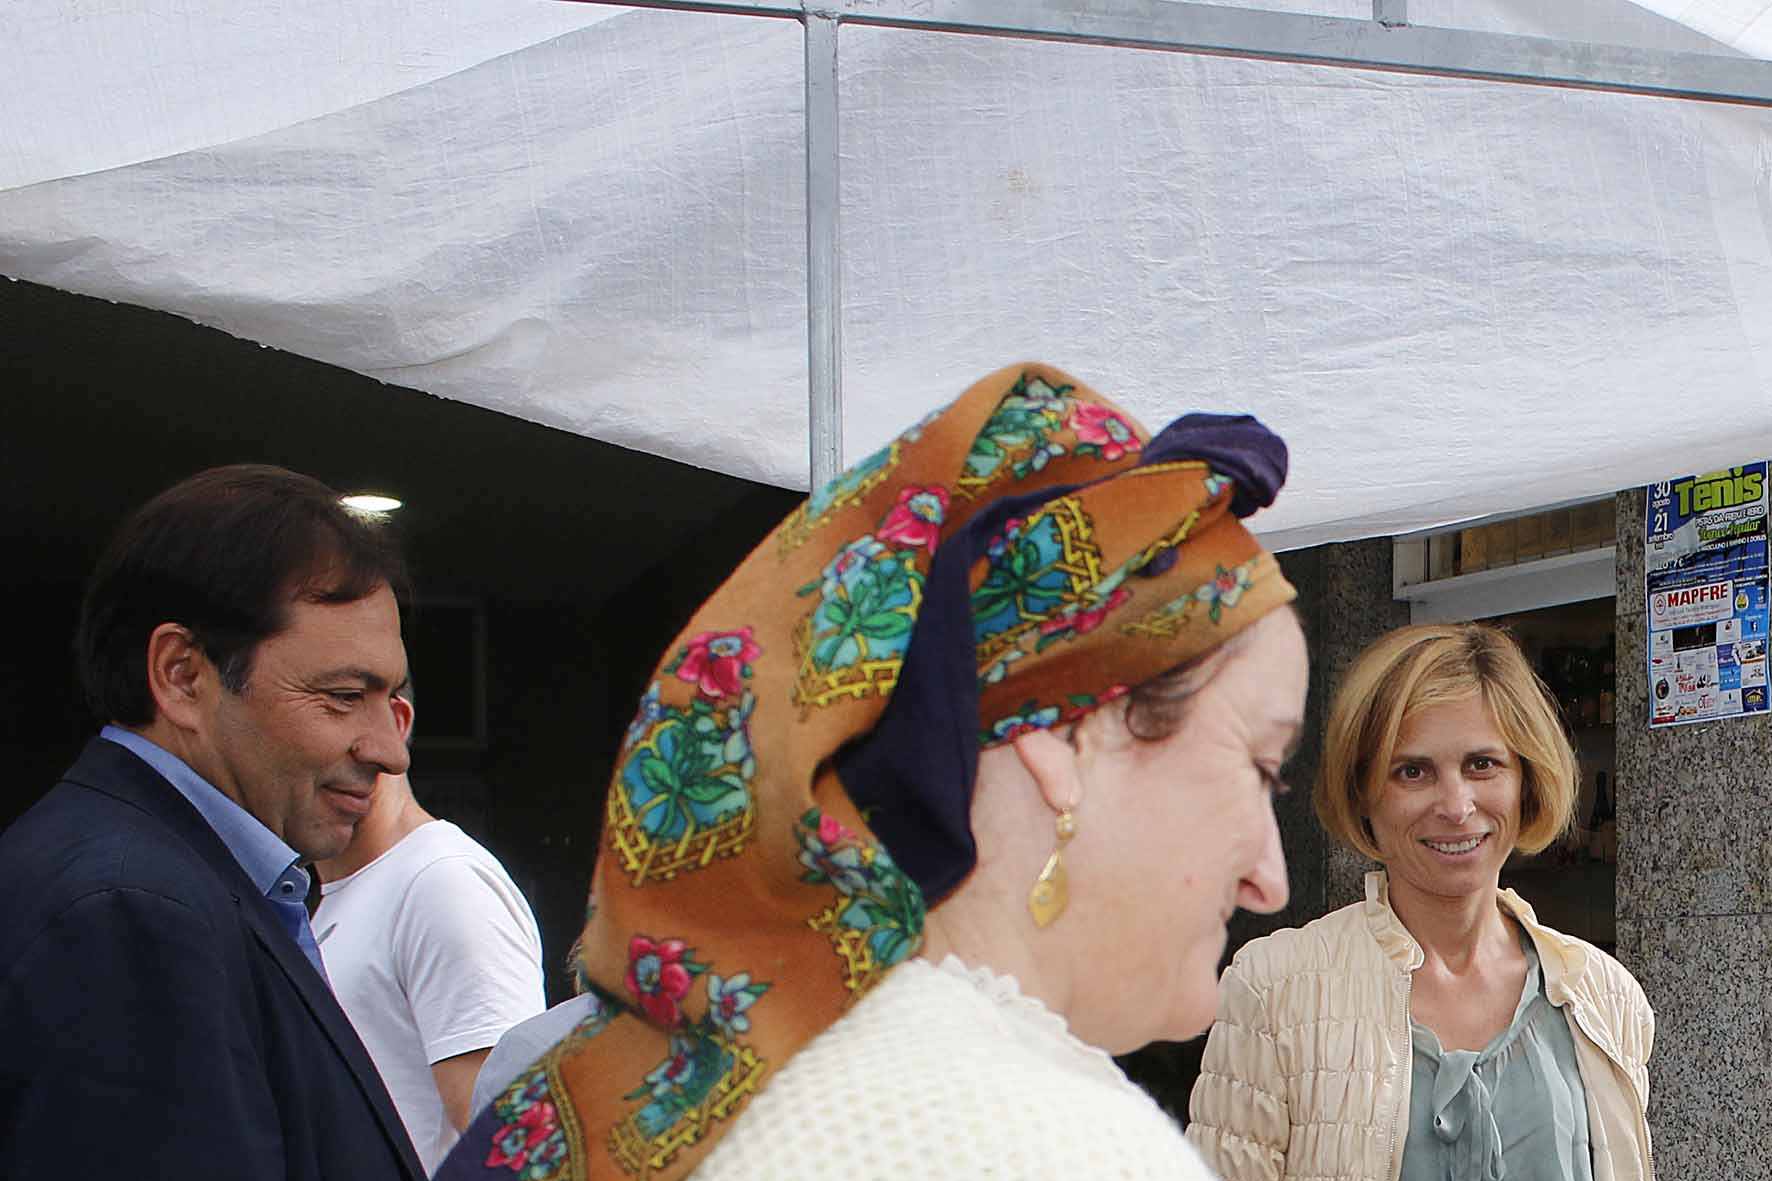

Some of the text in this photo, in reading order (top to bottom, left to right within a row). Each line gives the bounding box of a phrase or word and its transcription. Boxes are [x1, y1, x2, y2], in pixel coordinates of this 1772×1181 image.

[1654, 480, 1671, 499] 30
[1674, 467, 1762, 517] Tenis
[1654, 512, 1668, 533] 21
[1667, 583, 1729, 607] MAPFRE
